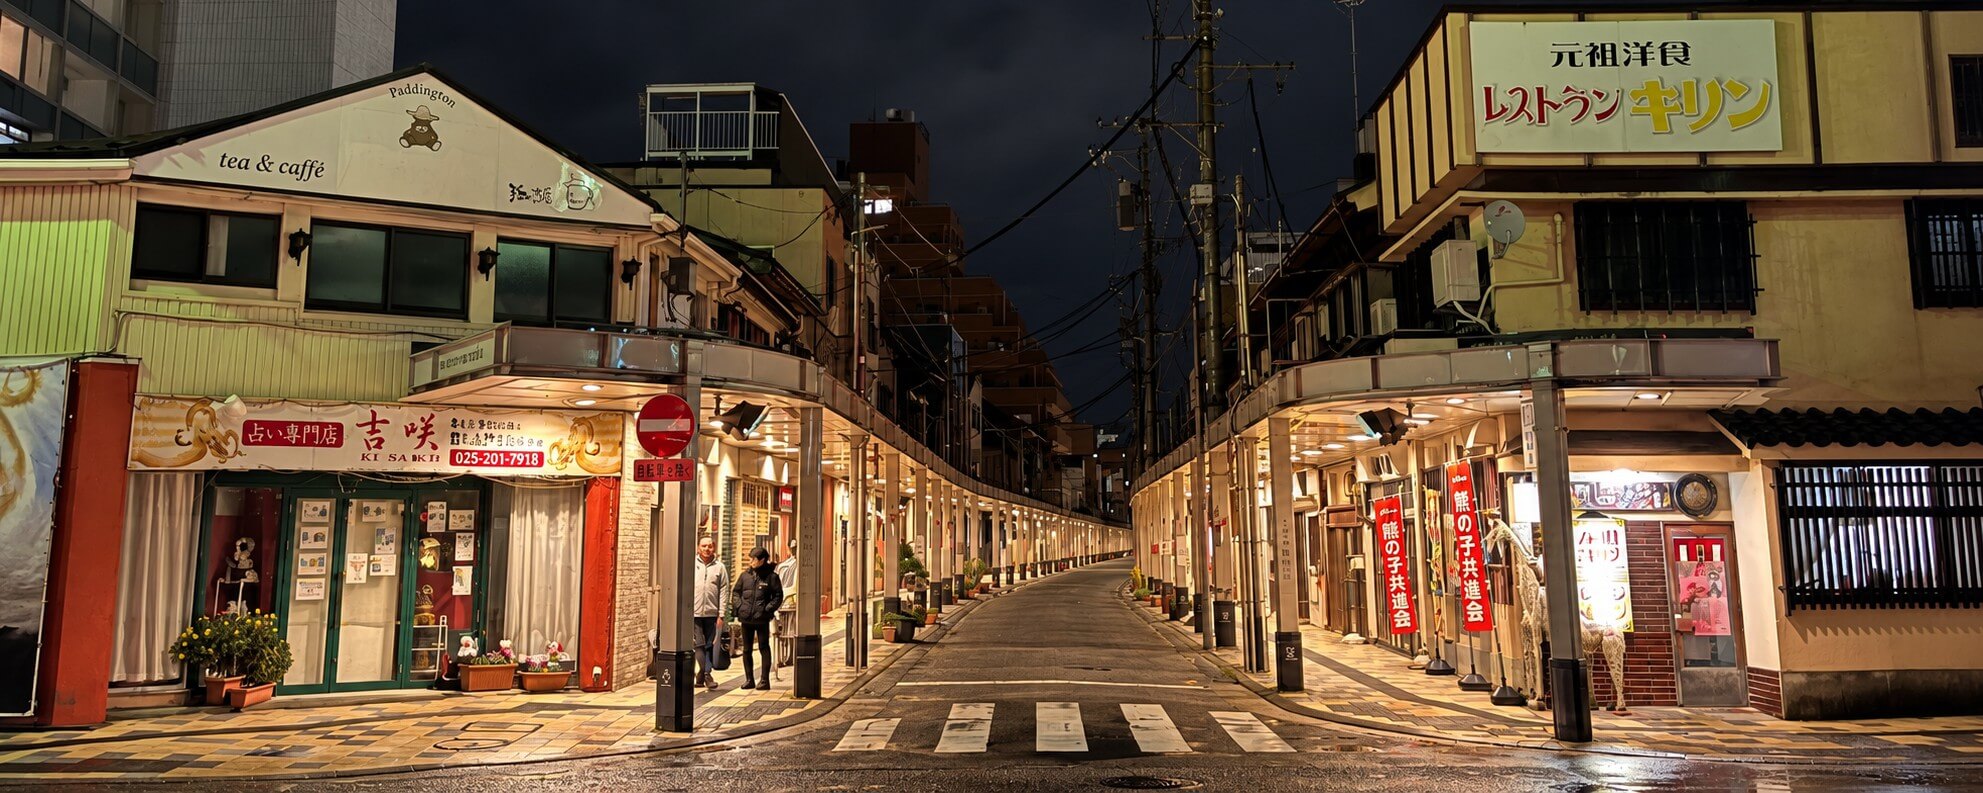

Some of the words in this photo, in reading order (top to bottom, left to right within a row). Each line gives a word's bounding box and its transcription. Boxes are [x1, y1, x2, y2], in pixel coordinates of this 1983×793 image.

[1550, 41, 1693, 68] 元祖洋食
[389, 83, 456, 108] Paddington
[1481, 84, 1621, 126] レストラン
[1628, 77, 1772, 134] キリン
[219, 152, 250, 171] tea
[255, 154, 274, 173] &
[279, 159, 325, 182] caffé
[248, 423, 338, 445] 占い専門店
[356, 409, 439, 451] 吉咲
[455, 451, 539, 466] 025-201-7918
[1453, 490, 1485, 623] 熊の子共進会
[1381, 521, 1412, 629] 熊の子共進会
